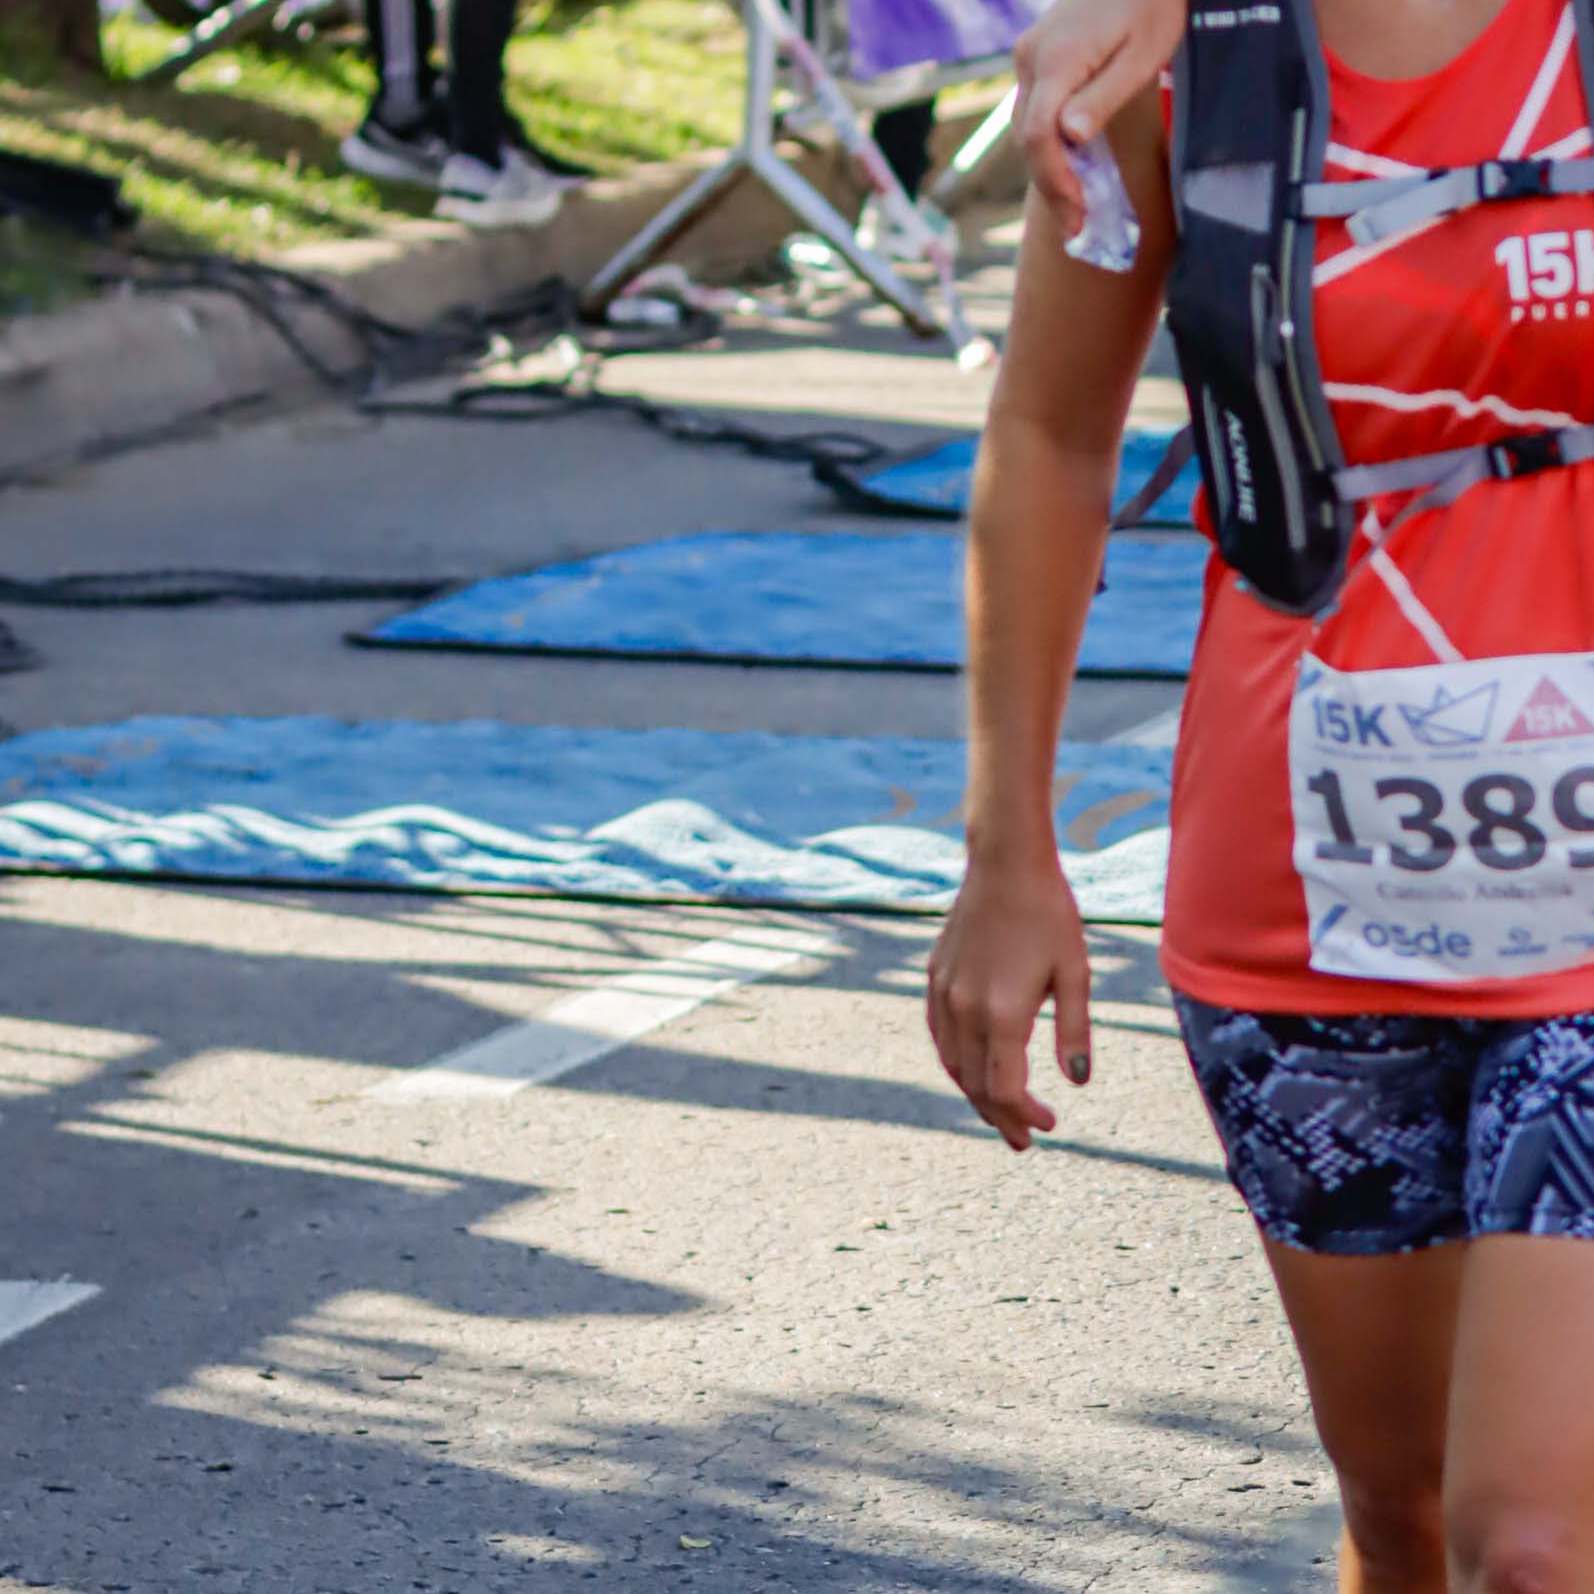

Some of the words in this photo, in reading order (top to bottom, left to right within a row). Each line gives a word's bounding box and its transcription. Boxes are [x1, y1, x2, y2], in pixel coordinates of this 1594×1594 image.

[1312, 695, 1393, 747] 15K
[1521, 705, 1579, 735] 15K
[1362, 921, 1472, 957] osde
